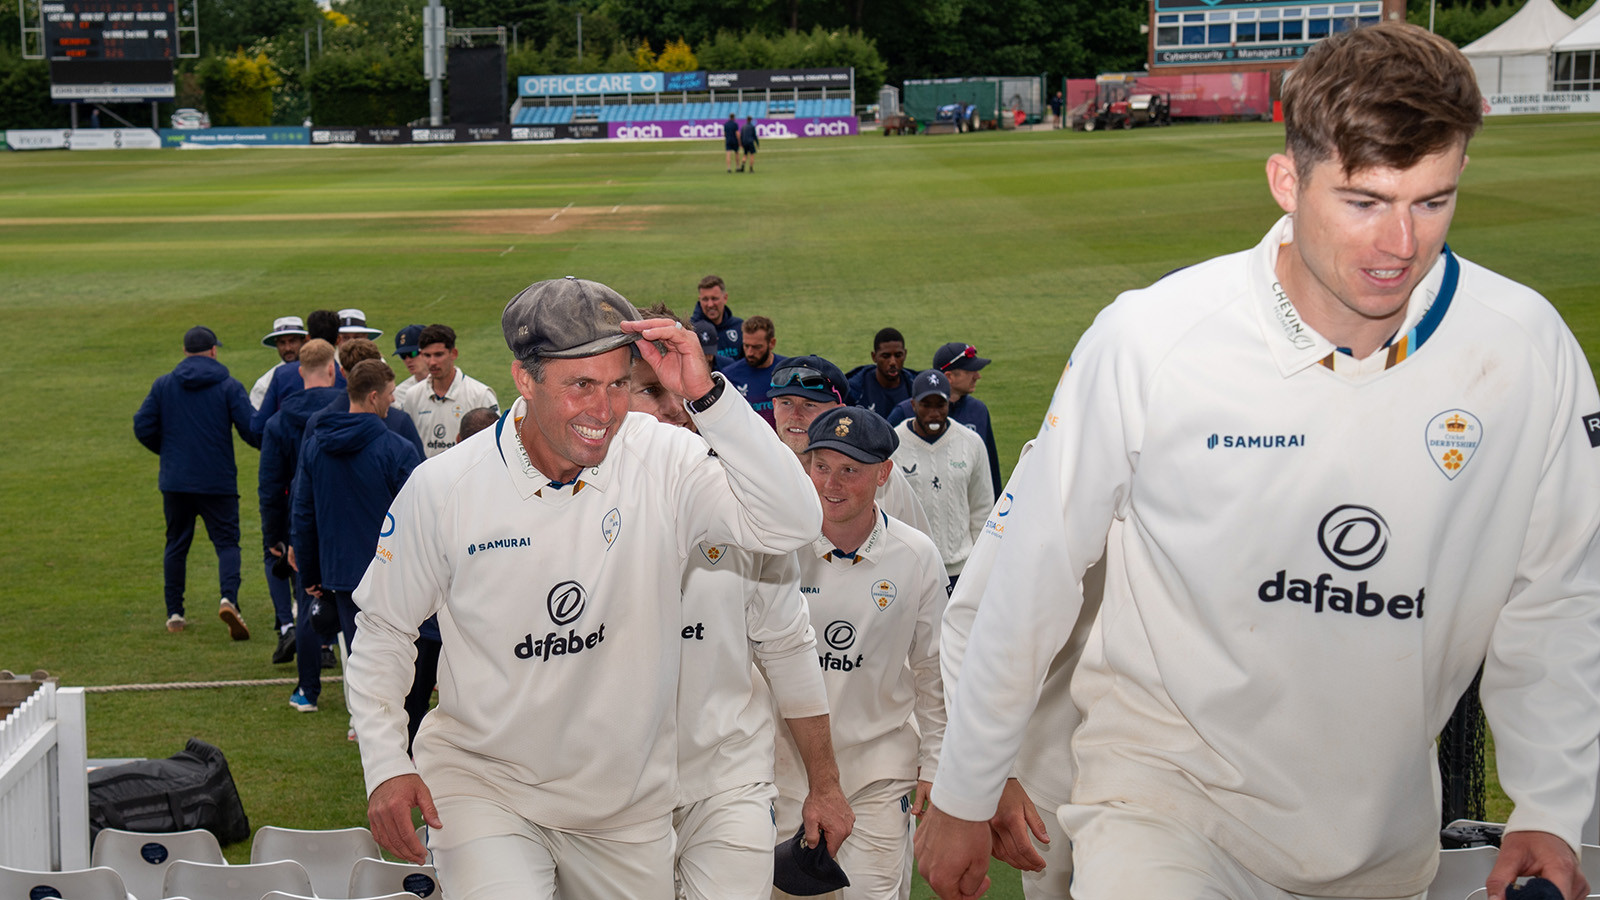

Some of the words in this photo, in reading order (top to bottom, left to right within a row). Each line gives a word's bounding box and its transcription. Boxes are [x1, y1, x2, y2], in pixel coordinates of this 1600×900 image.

[1163, 50, 1224, 62] Cybersecurity
[1237, 48, 1281, 60] Managed
[1282, 47, 1293, 56] IT
[525, 76, 632, 94] OFFICECARE
[1491, 94, 1540, 104] CARLSBERG
[1542, 93, 1591, 102] MARSTON'S
[1511, 105, 1539, 113] BREWING
[617, 122, 663, 138] cinch
[679, 122, 725, 138] cinch
[804, 119, 849, 136] cinch
[1272, 282, 1304, 333] CHEVIN
[1223, 434, 1305, 448] SAMURAI
[1430, 440, 1476, 448] DERBYSHIRE
[478, 537, 531, 551] SAMURAI
[865, 530, 878, 554] CHEVIN
[1258, 569, 1426, 620] dafabet
[514, 623, 605, 662] dafabet
